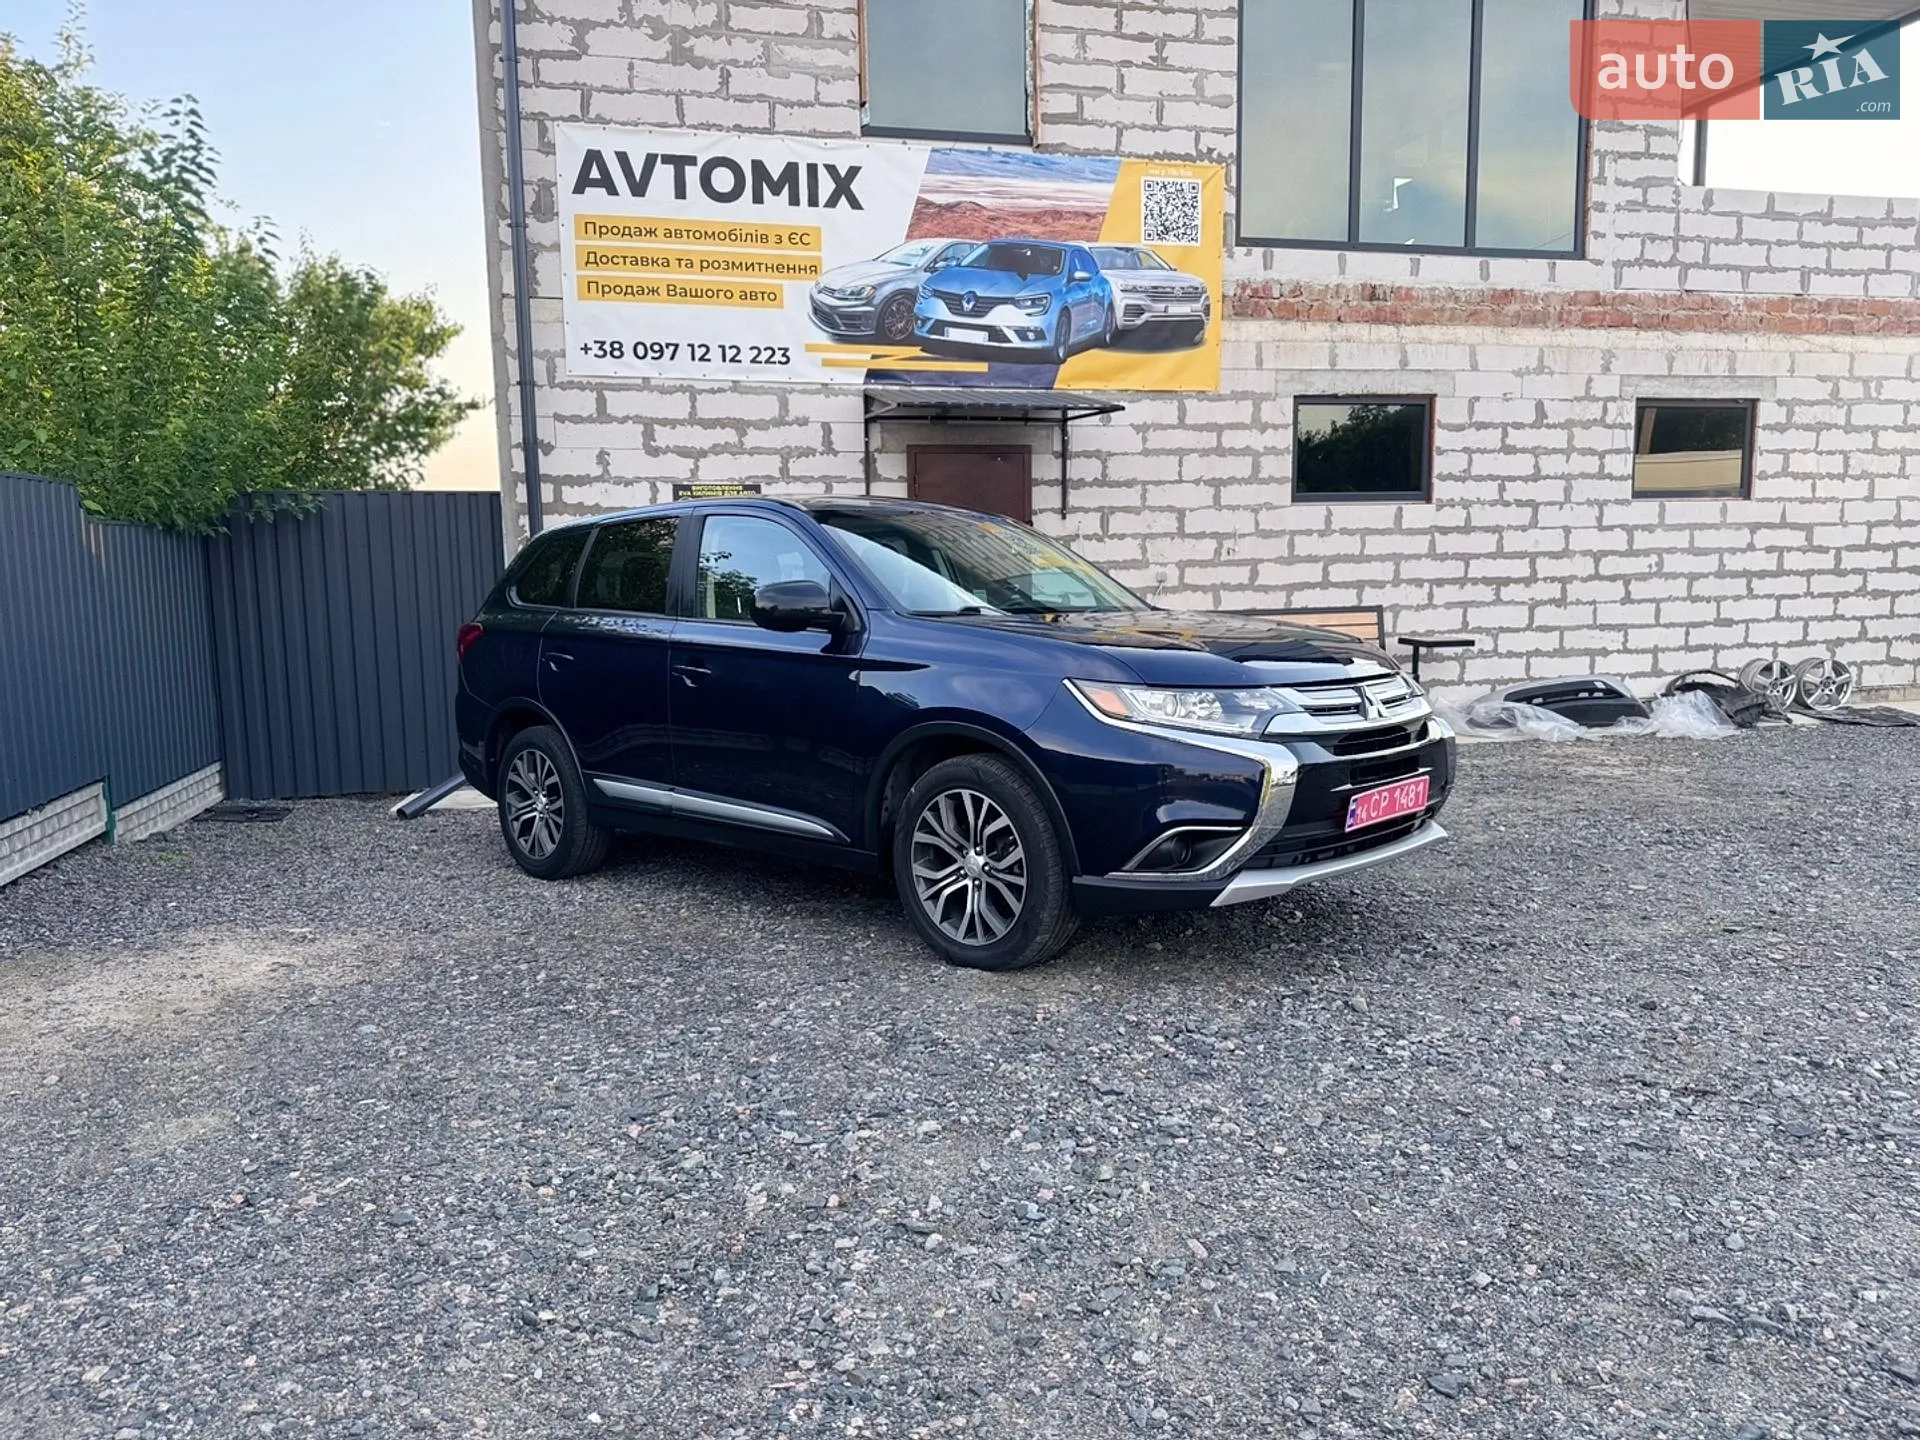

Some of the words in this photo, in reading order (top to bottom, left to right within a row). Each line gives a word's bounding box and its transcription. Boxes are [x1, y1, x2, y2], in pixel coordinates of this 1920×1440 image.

[572, 148, 865, 211] AVTOMIX
[583, 221, 658, 238] Продаж
[663, 226, 770, 244] автомобілів
[774, 233, 783, 245] з
[788, 232, 811, 246] ЄС
[585, 251, 670, 268] Доставка
[676, 256, 694, 269] та
[700, 257, 818, 275] розмитнення
[586, 280, 661, 297] Продаж
[666, 283, 734, 301] Вашого
[739, 289, 777, 302] авто
[579, 340, 625, 360] +38
[632, 341, 680, 361] 097
[687, 342, 711, 362] 12
[717, 344, 742, 363] 12
[749, 345, 791, 366] 223
[1356, 803, 1369, 824] 14
[1394, 781, 1424, 811] 1481
